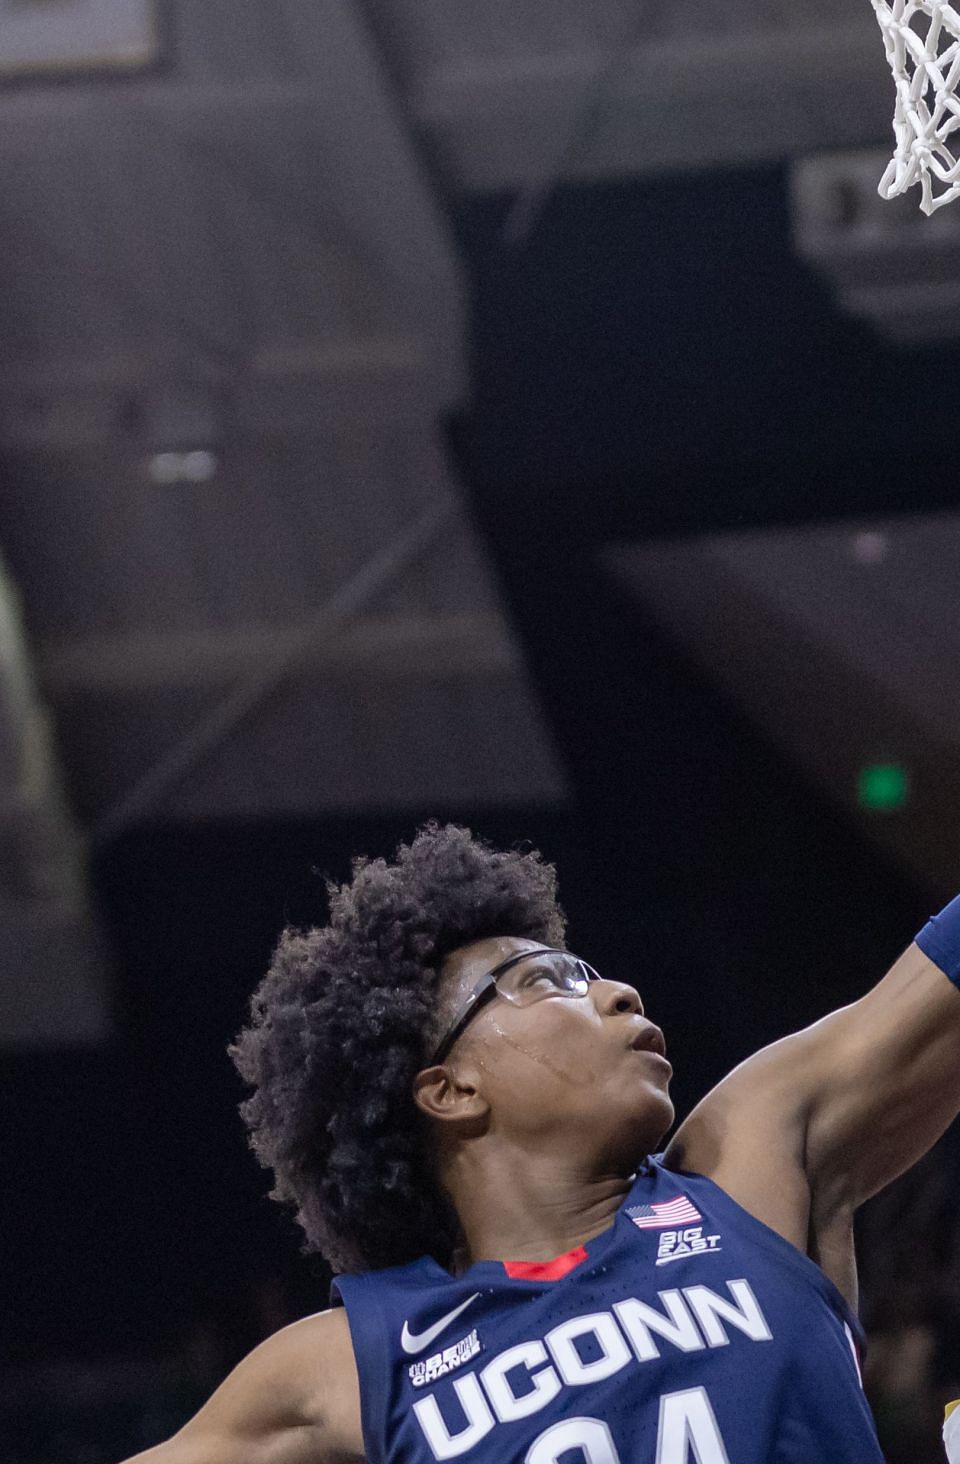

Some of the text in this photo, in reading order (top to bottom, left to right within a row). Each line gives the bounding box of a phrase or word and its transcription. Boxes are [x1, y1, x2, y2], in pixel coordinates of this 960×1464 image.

[657, 1235, 721, 1257] EAST
[659, 1227, 703, 1244] BIG
[412, 1340, 480, 1387] CHANGE
[412, 1279, 774, 1461] UCONN
